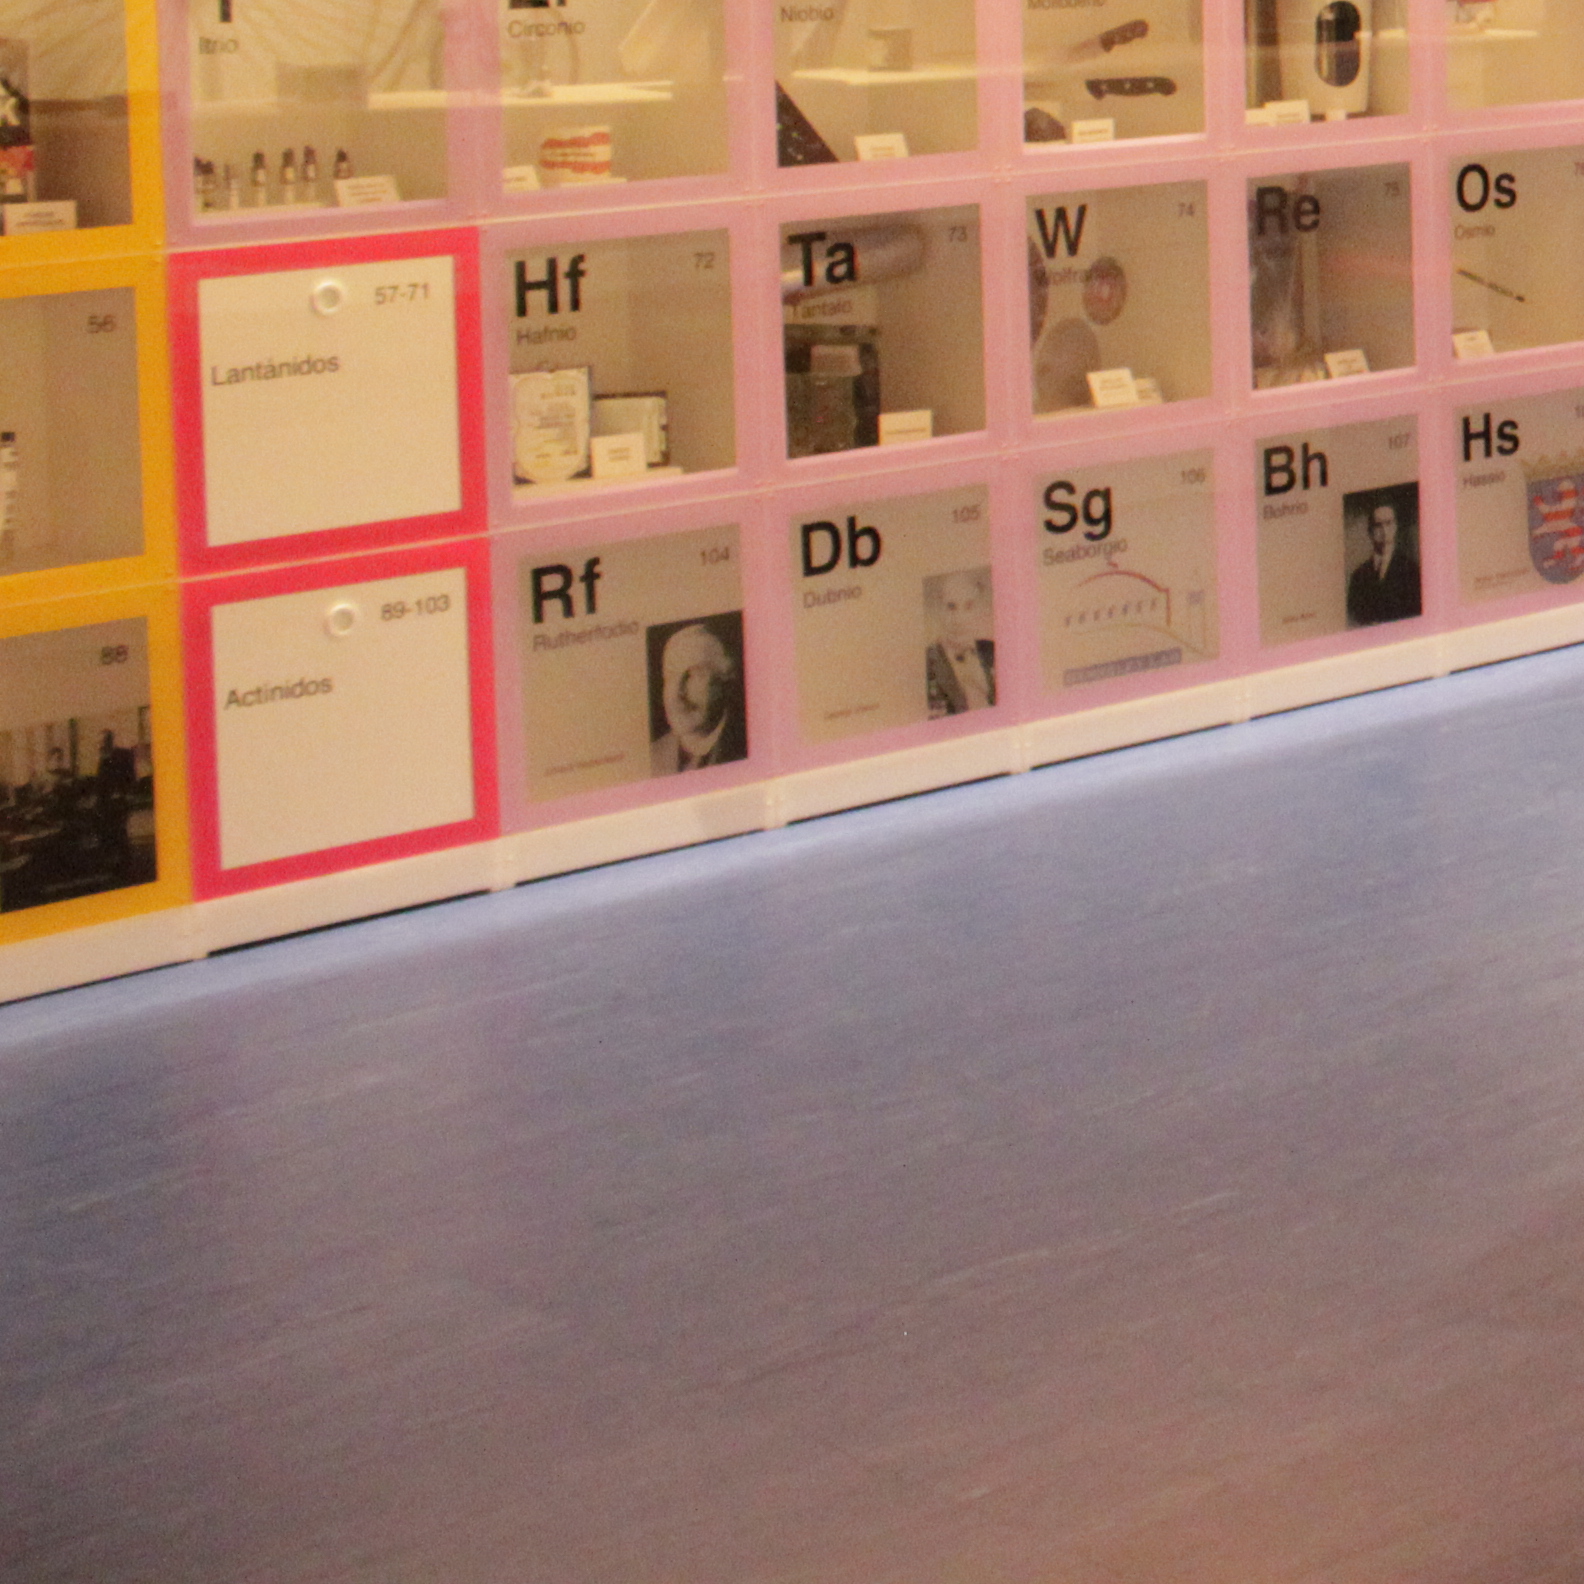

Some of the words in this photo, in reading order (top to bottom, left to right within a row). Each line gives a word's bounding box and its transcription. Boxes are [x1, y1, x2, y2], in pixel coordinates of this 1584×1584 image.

[507, 17, 586, 38] Circonio
[1256, 185, 1321, 236] Re
[1456, 163, 1517, 213] Os
[1035, 204, 1087, 261] W
[788, 231, 858, 287] Ta
[374, 283, 431, 306] 57-71
[513, 253, 586, 317] Hf
[515, 325, 577, 347] Hafnio
[210, 352, 340, 388] Lantánidos
[1461, 412, 1520, 464] Hs
[1263, 444, 1328, 497] Bh
[1042, 480, 1113, 543] Sg
[801, 516, 881, 577] Db
[1043, 536, 1129, 566] Seaborgio
[530, 557, 602, 624] Rf
[225, 674, 333, 711] Actínidos
